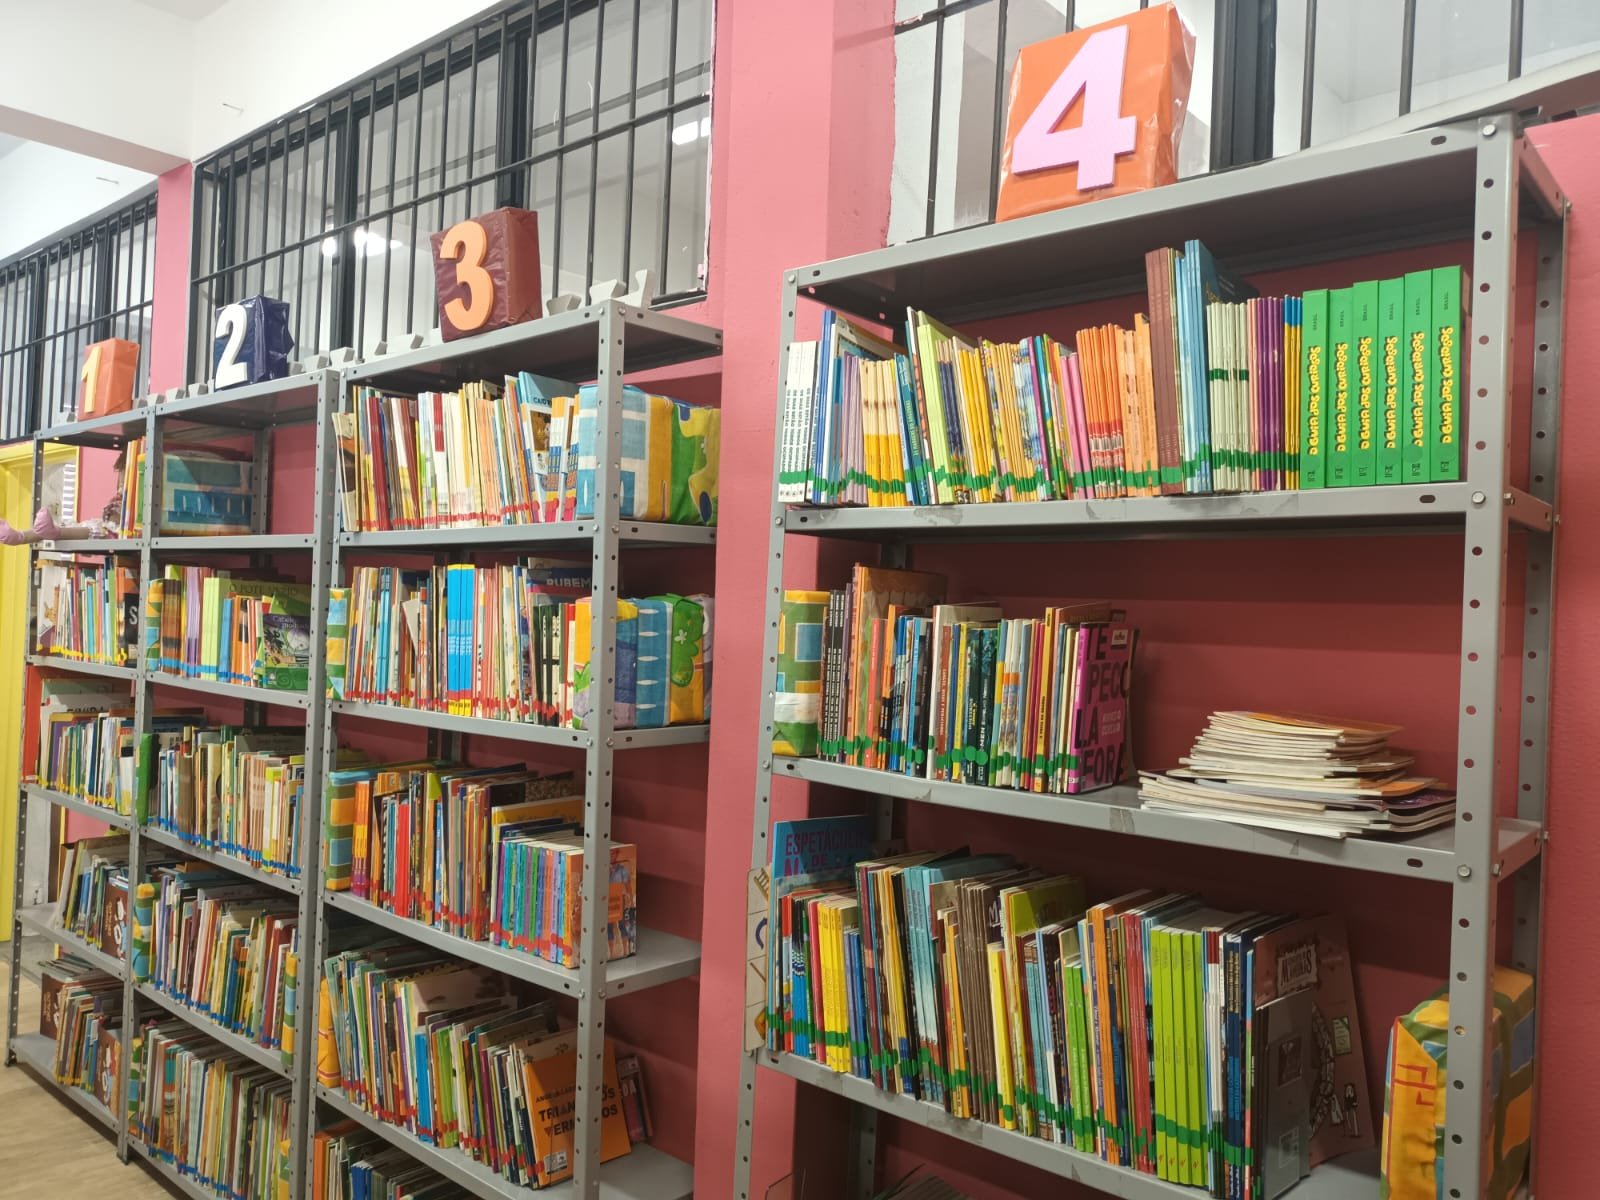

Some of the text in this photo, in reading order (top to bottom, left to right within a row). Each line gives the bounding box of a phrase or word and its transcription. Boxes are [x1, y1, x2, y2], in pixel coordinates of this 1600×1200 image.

[1011, 23, 1138, 191] 4
[440, 220, 495, 331] 3
[214, 304, 250, 389] 2
[1308, 345, 1321, 393] CURIOSOS
[1336, 342, 1348, 390] CURIOSOS
[1360, 336, 1372, 385] CURIOSOS
[1385, 336, 1398, 385] CURIOSOS
[1413, 331, 1425, 381] CURIOSOS
[1441, 326, 1454, 376] CURIOSOS
[81, 345, 101, 414] 1
